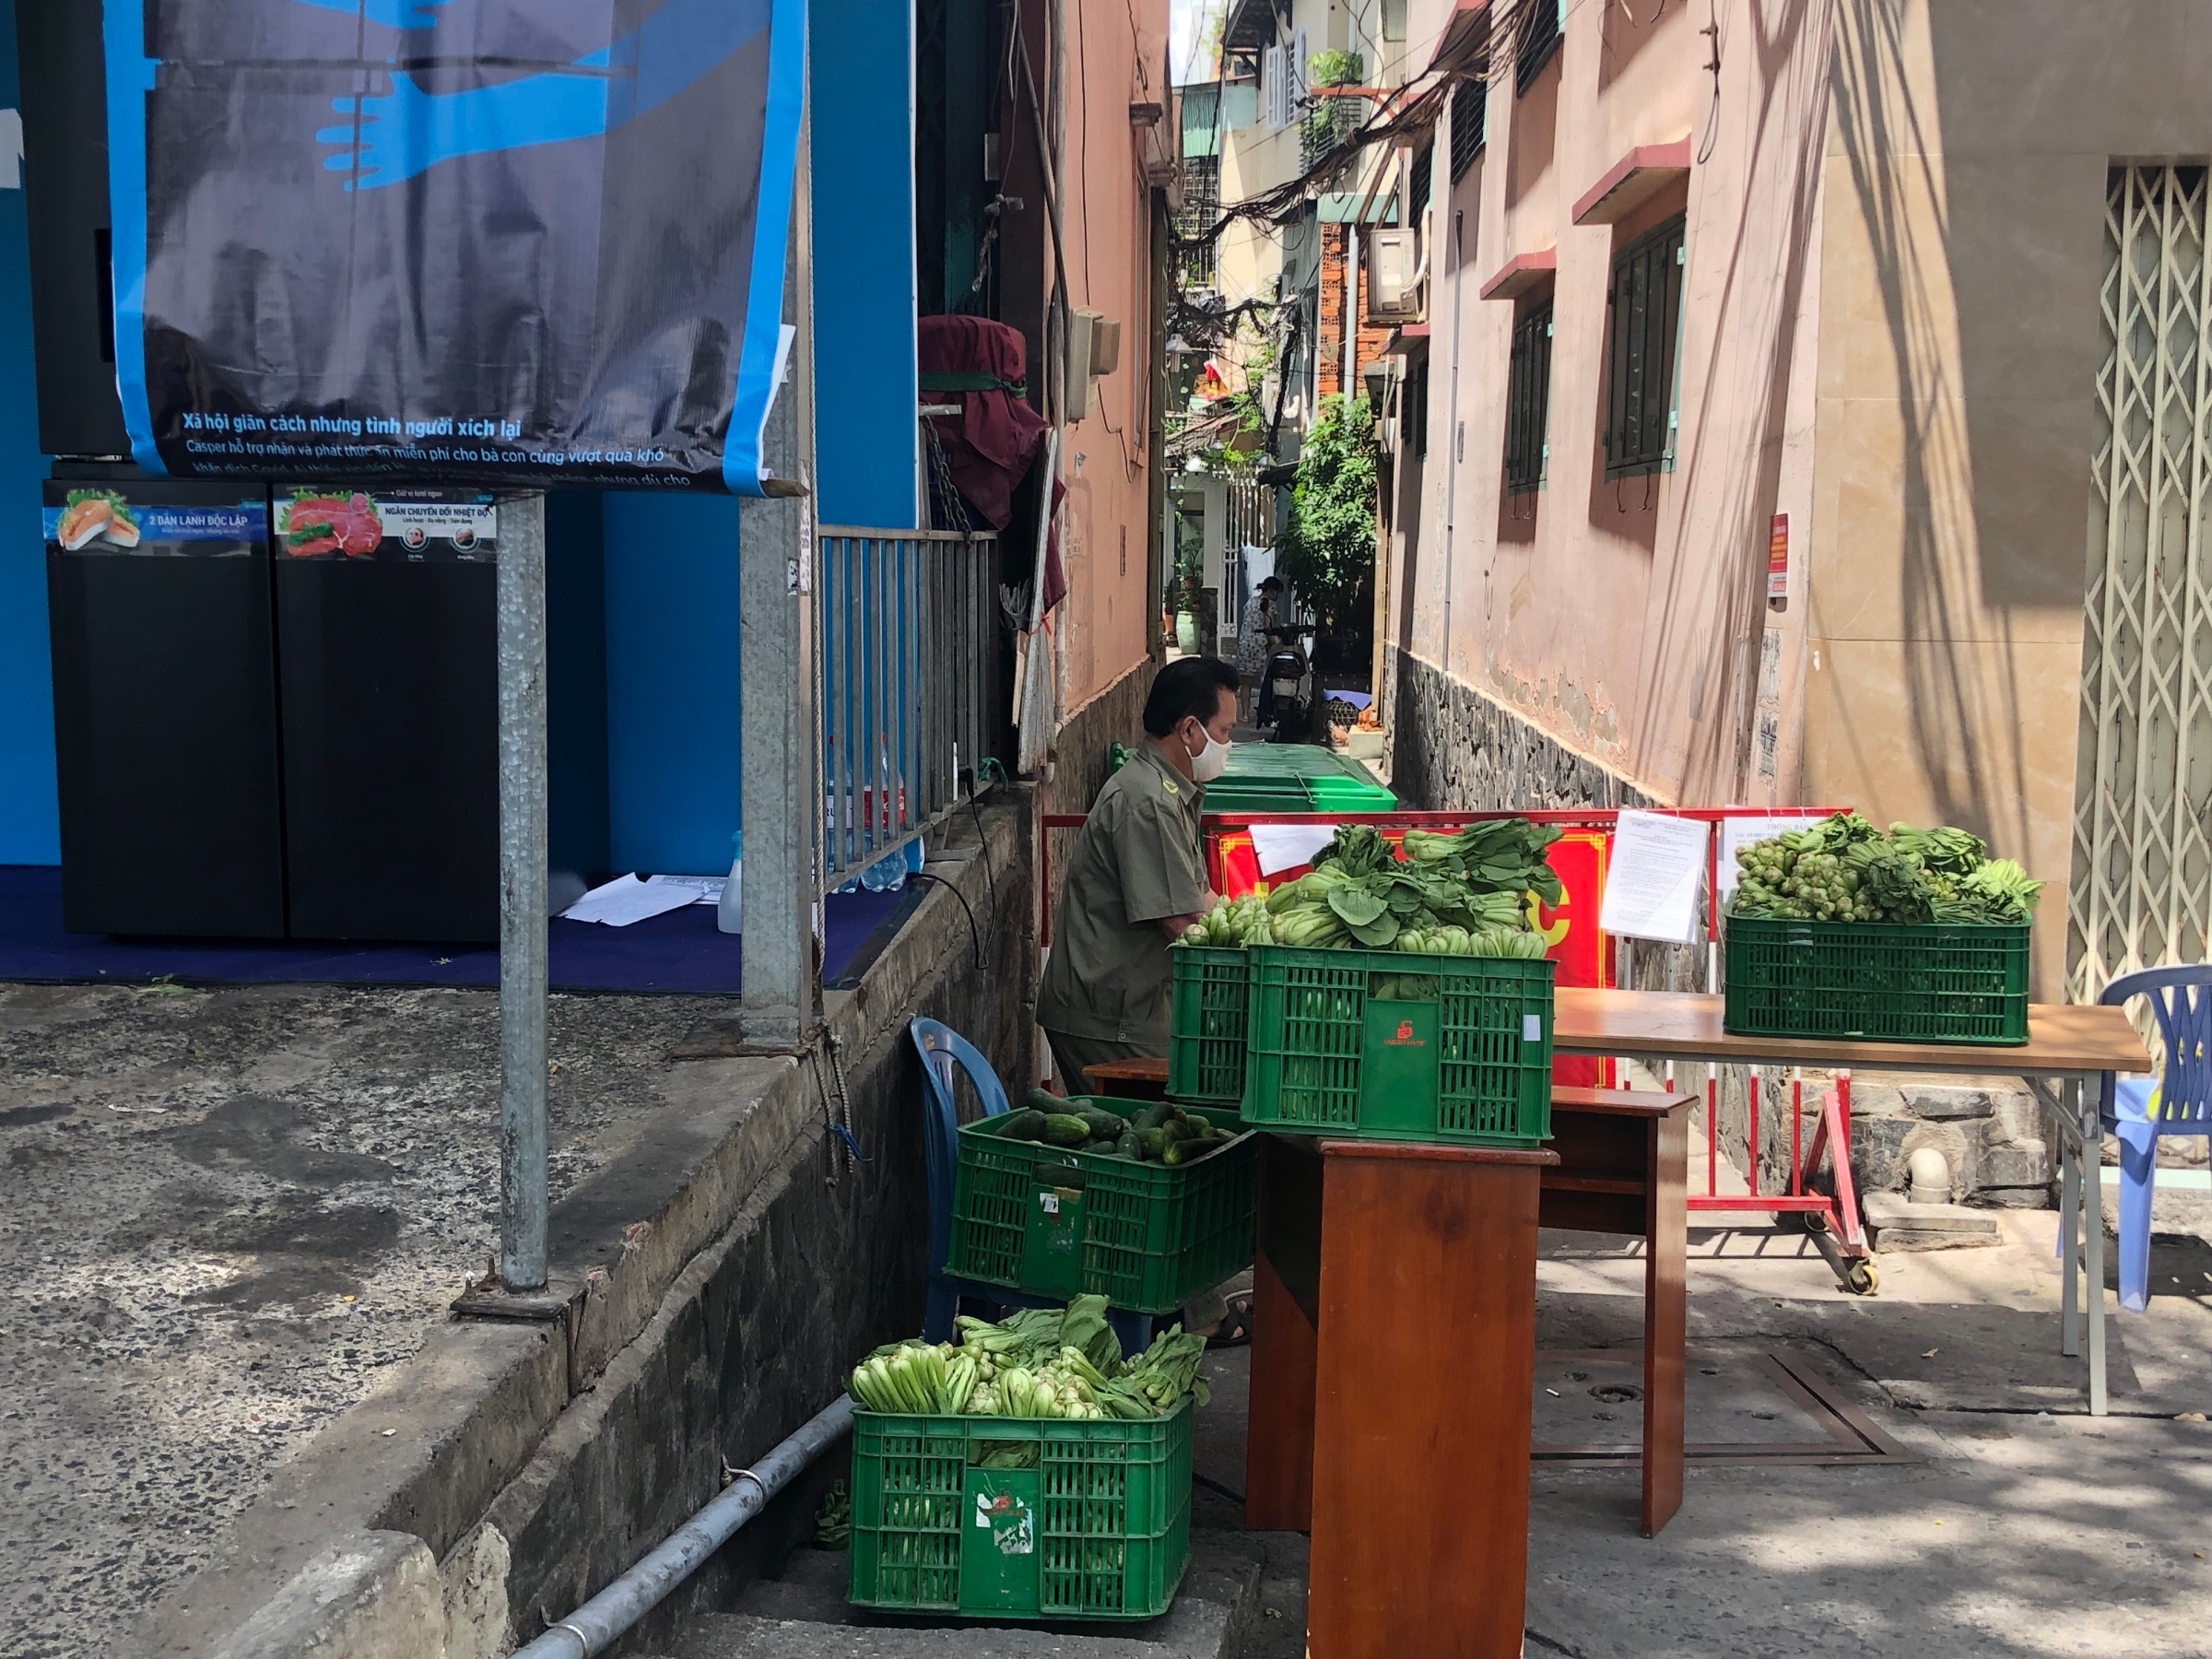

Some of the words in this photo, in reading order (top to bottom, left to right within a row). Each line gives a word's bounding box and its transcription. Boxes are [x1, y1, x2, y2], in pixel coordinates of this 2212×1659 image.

[182, 413, 203, 429] Xã
[205, 414, 229, 434] hội
[233, 414, 266, 433] giãn
[269, 415, 306, 432] cách
[310, 417, 361, 436] nhưng
[366, 417, 402, 435] tình
[405, 417, 453, 438] người
[457, 418, 495, 437] xích
[500, 419, 522, 441] lại
[186, 440, 226, 455] Casper
[229, 438, 244, 453] hỗ
[246, 442, 265, 456] trợ
[266, 442, 295, 457] nhận
[298, 443, 312, 455] và
[315, 443, 342, 458] phát
[394, 443, 427, 460] miễn
[429, 446, 450, 462] phí
[453, 447, 477, 462] cho
[481, 447, 499, 462] bà
[501, 451, 526, 463] con
[529, 449, 564, 465] cùng
[569, 449, 602, 465] vượt
[605, 450, 633, 465] qua
[637, 446, 665, 462] khó
[664, 474, 691, 486] cho
[149, 516, 156, 525] 2
[158, 512, 178, 525] DÀN
[180, 516, 206, 528] LẠNH
[207, 514, 227, 528] ĐỘC
[229, 514, 249, 528] LẬP
